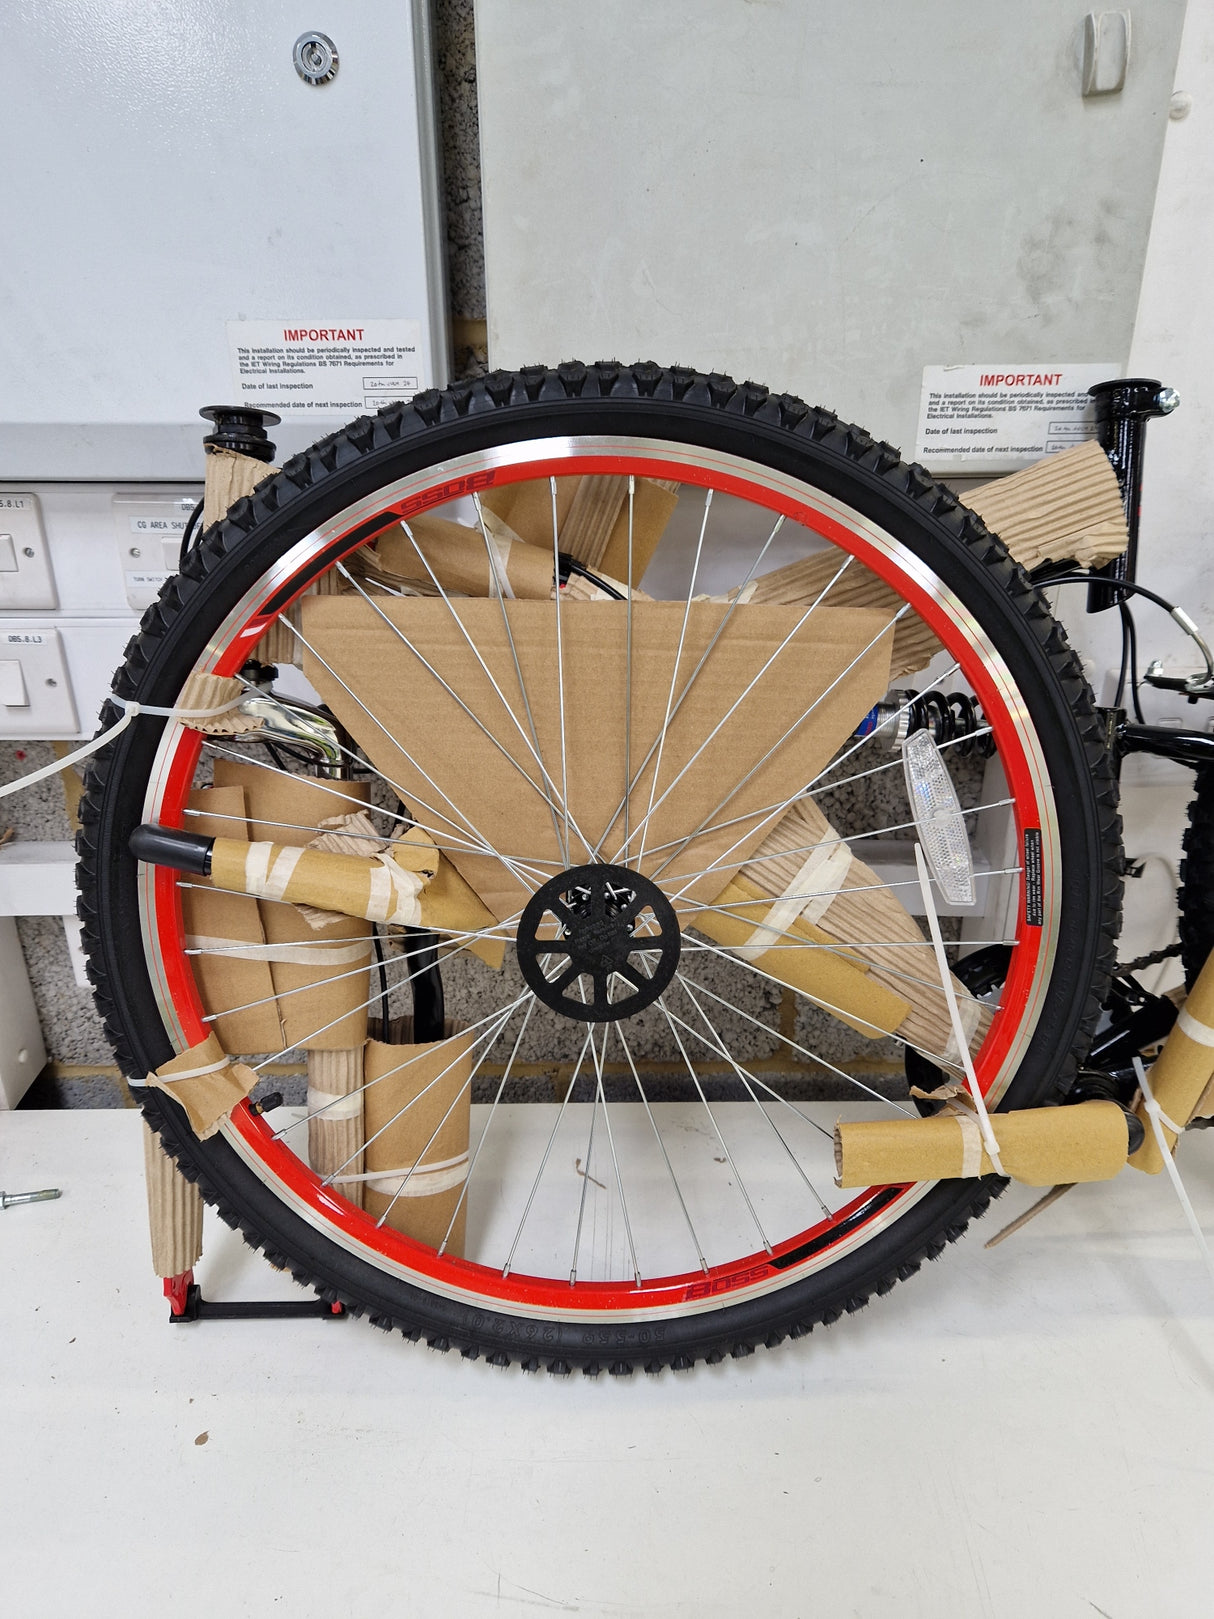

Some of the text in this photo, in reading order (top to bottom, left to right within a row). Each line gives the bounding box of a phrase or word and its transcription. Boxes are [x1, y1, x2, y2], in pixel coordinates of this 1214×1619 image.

[284, 329, 364, 341] IMPORTANT
[980, 374, 1062, 387] IMPORTANT
[401, 470, 496, 513] BOSS
[685, 1265, 768, 1301] BOSS
